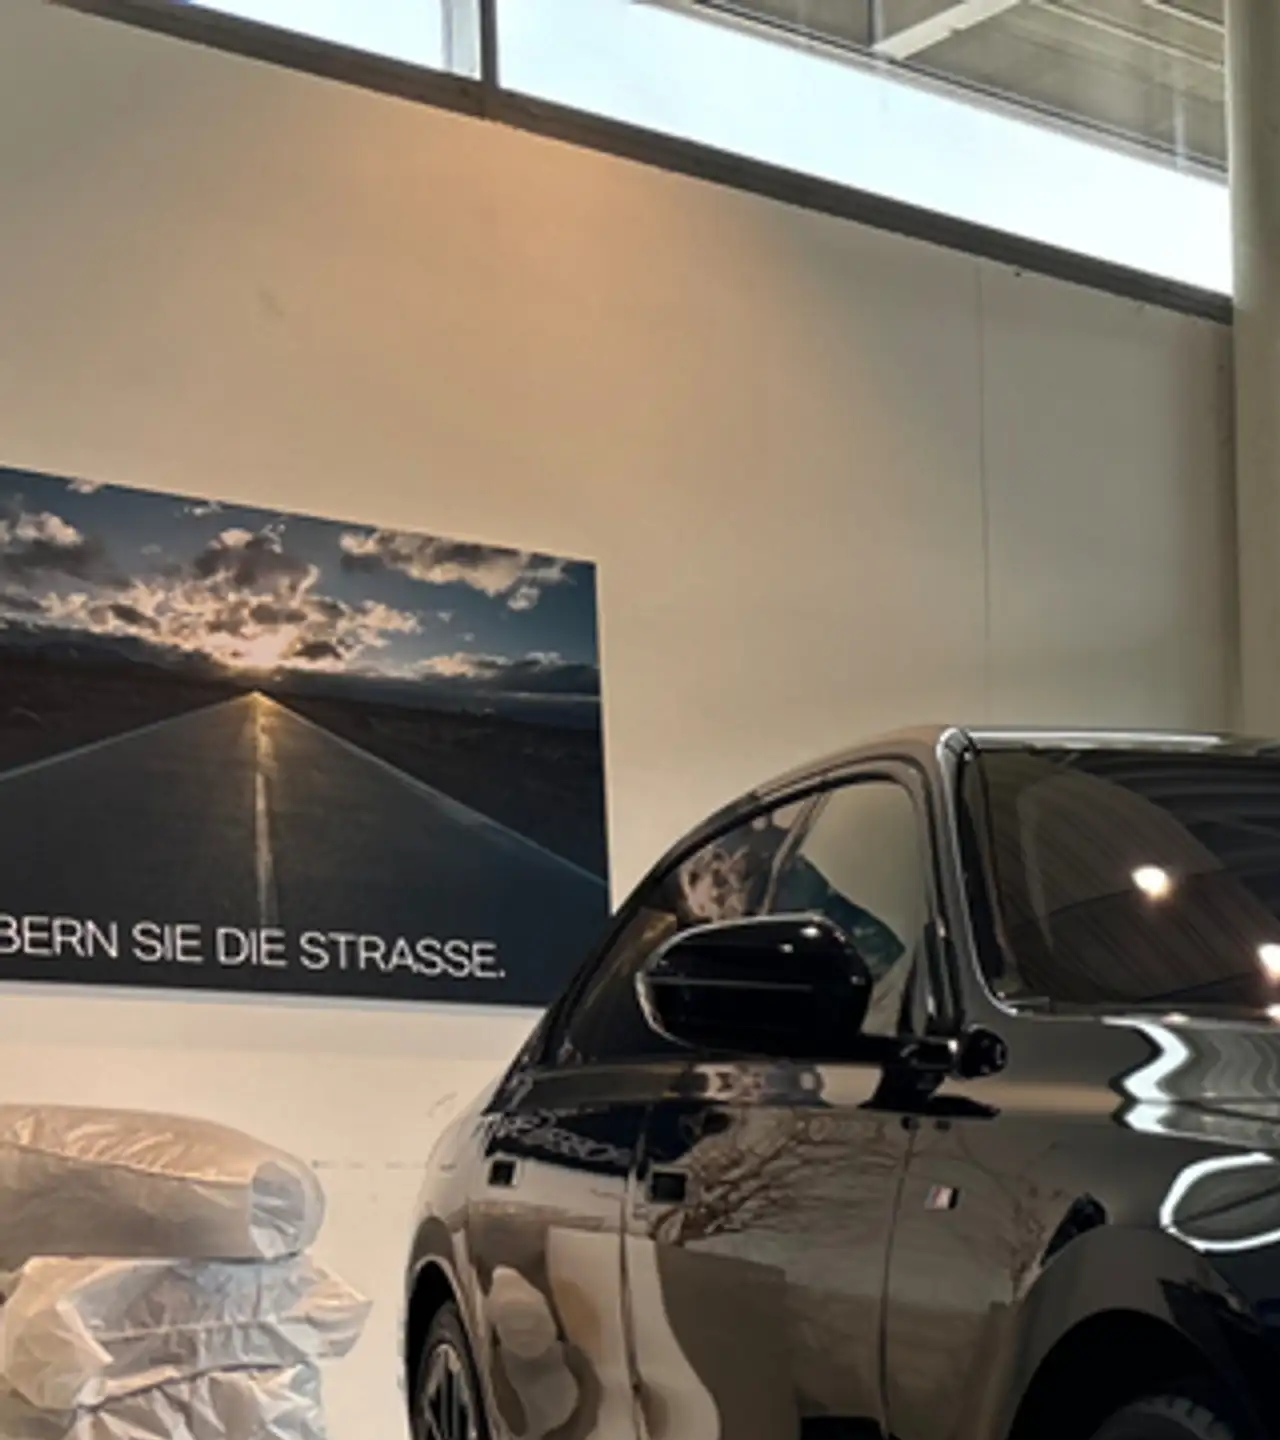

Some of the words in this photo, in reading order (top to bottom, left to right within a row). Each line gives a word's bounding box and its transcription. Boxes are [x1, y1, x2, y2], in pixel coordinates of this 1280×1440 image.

[131, 920, 203, 963] SIE
[215, 926, 288, 968] DIE
[299, 930, 506, 979] STRASSE.
